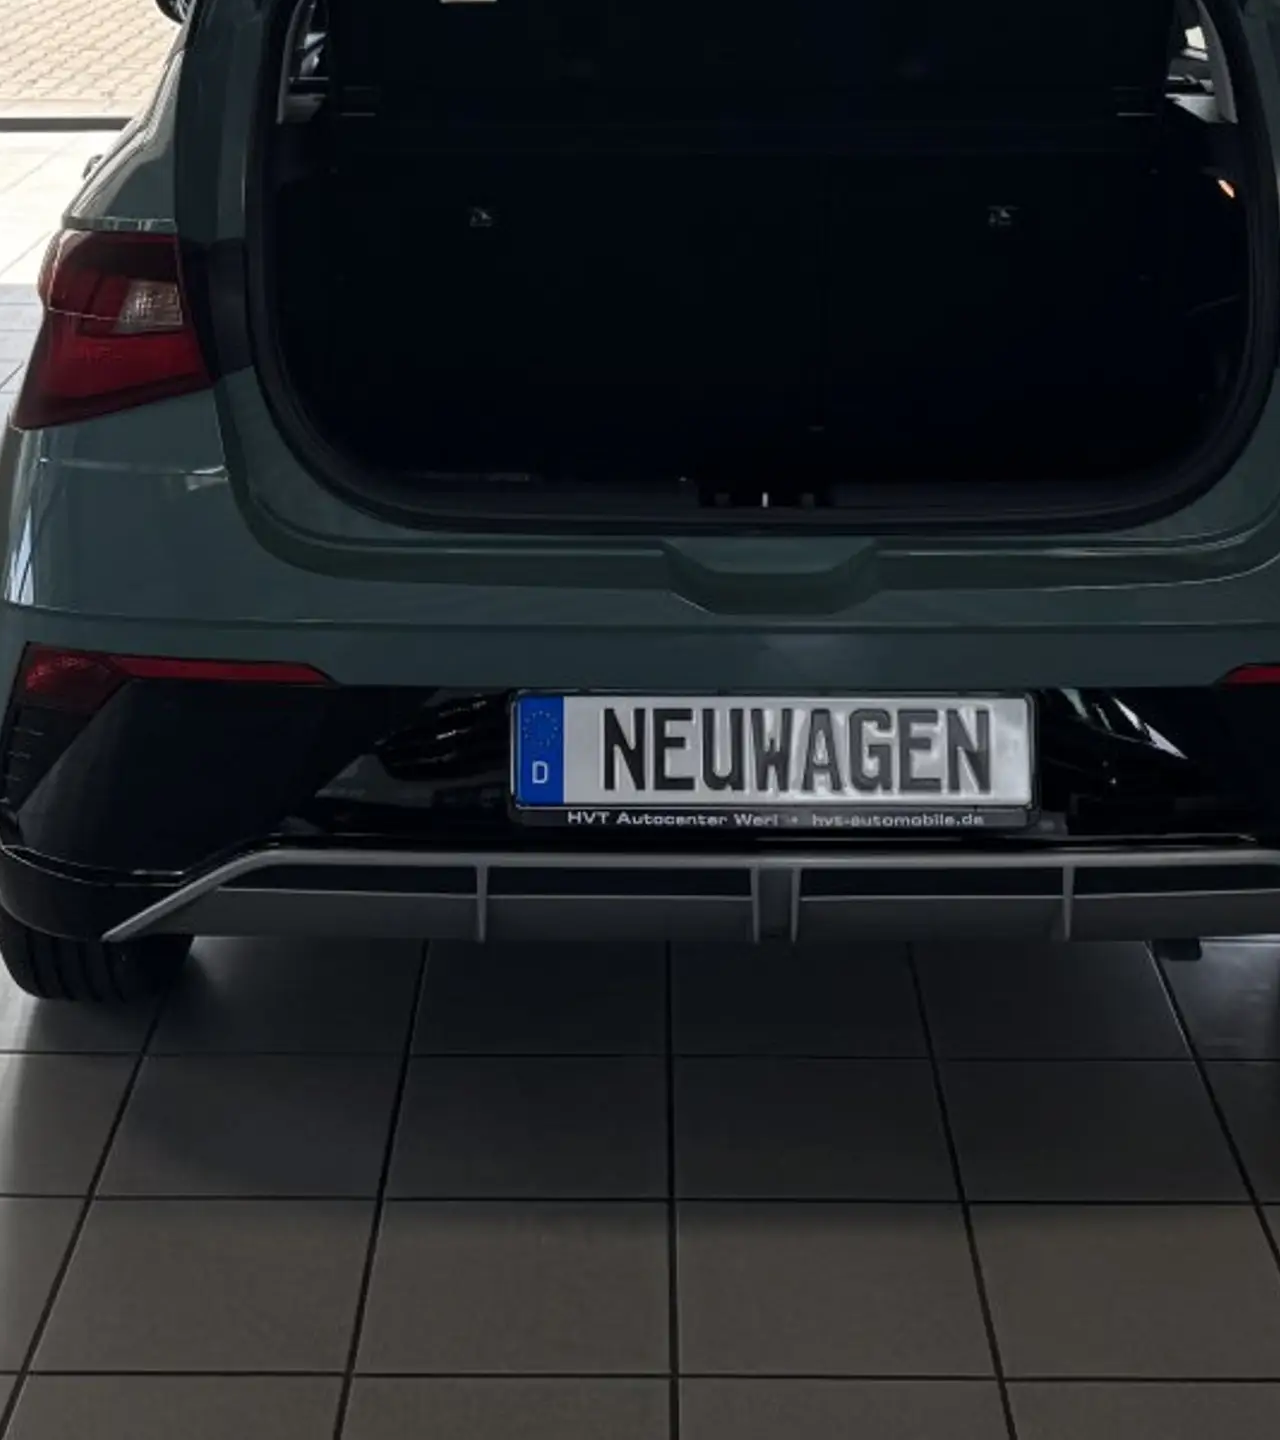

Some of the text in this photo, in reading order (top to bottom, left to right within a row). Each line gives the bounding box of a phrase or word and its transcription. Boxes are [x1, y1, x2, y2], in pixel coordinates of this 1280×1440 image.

[603, 707, 991, 795] NEUWAGEN
[531, 761, 549, 784] D
[567, 811, 610, 825] HVT
[616, 811, 728, 826] Autocenter
[733, 813, 779, 827] Werl
